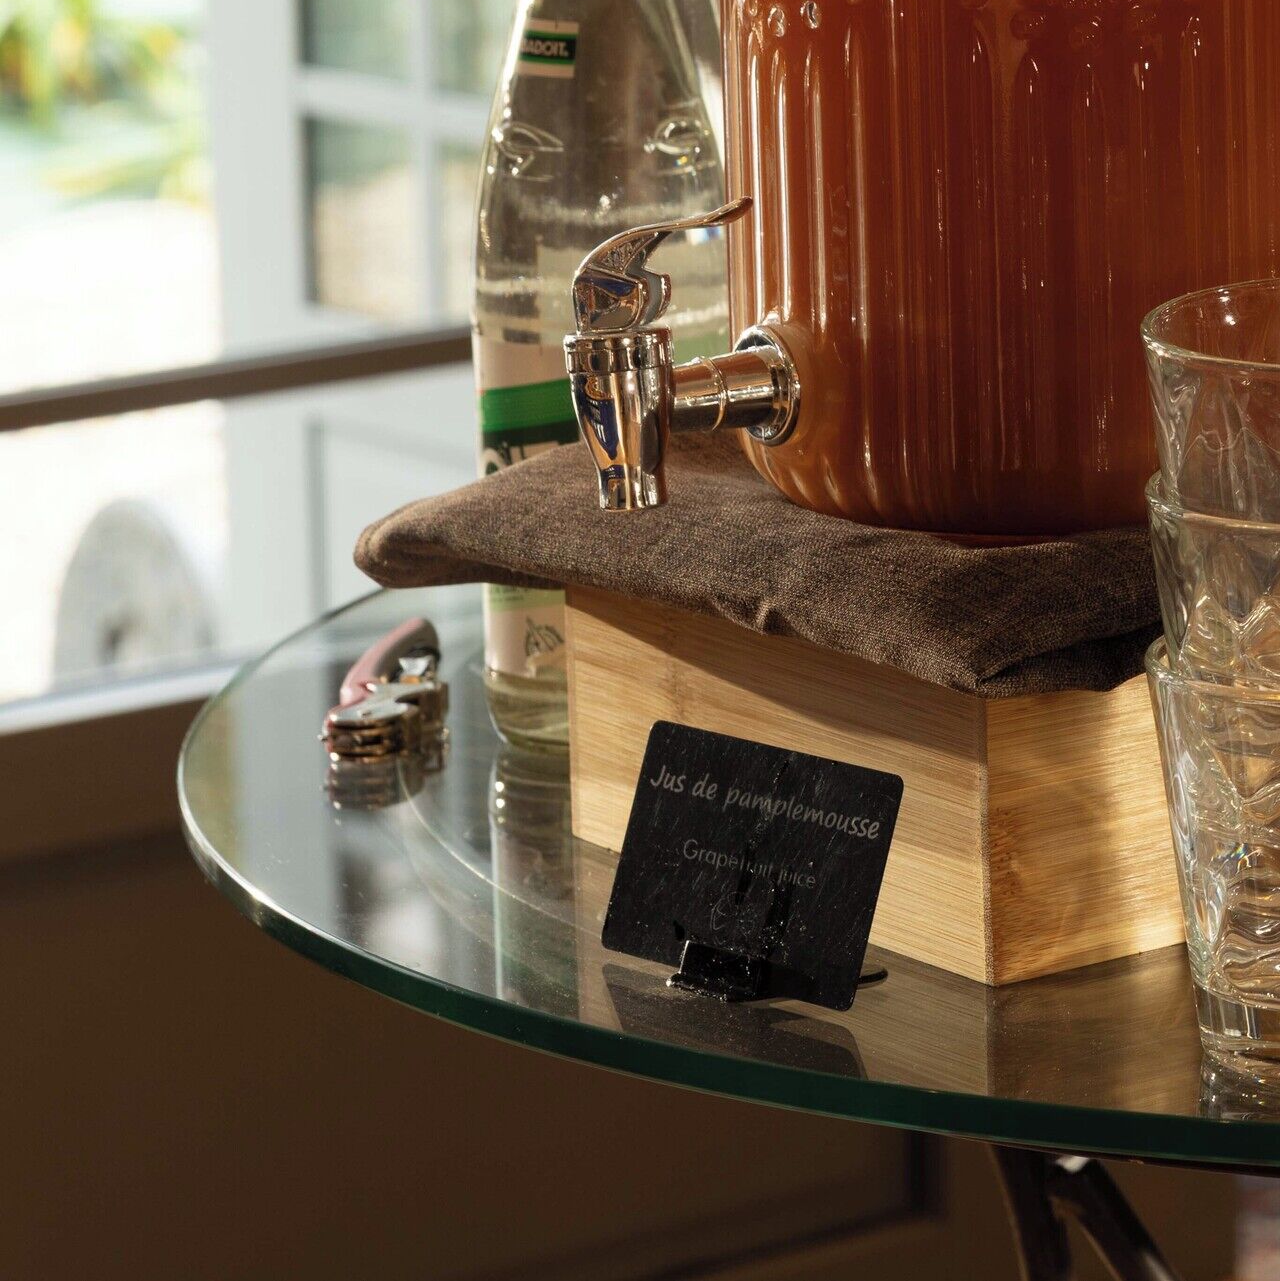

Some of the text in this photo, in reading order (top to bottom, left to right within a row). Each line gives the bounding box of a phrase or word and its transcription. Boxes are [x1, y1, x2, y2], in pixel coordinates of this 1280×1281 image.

[650, 765, 881, 840] Jus de pamplemousse
